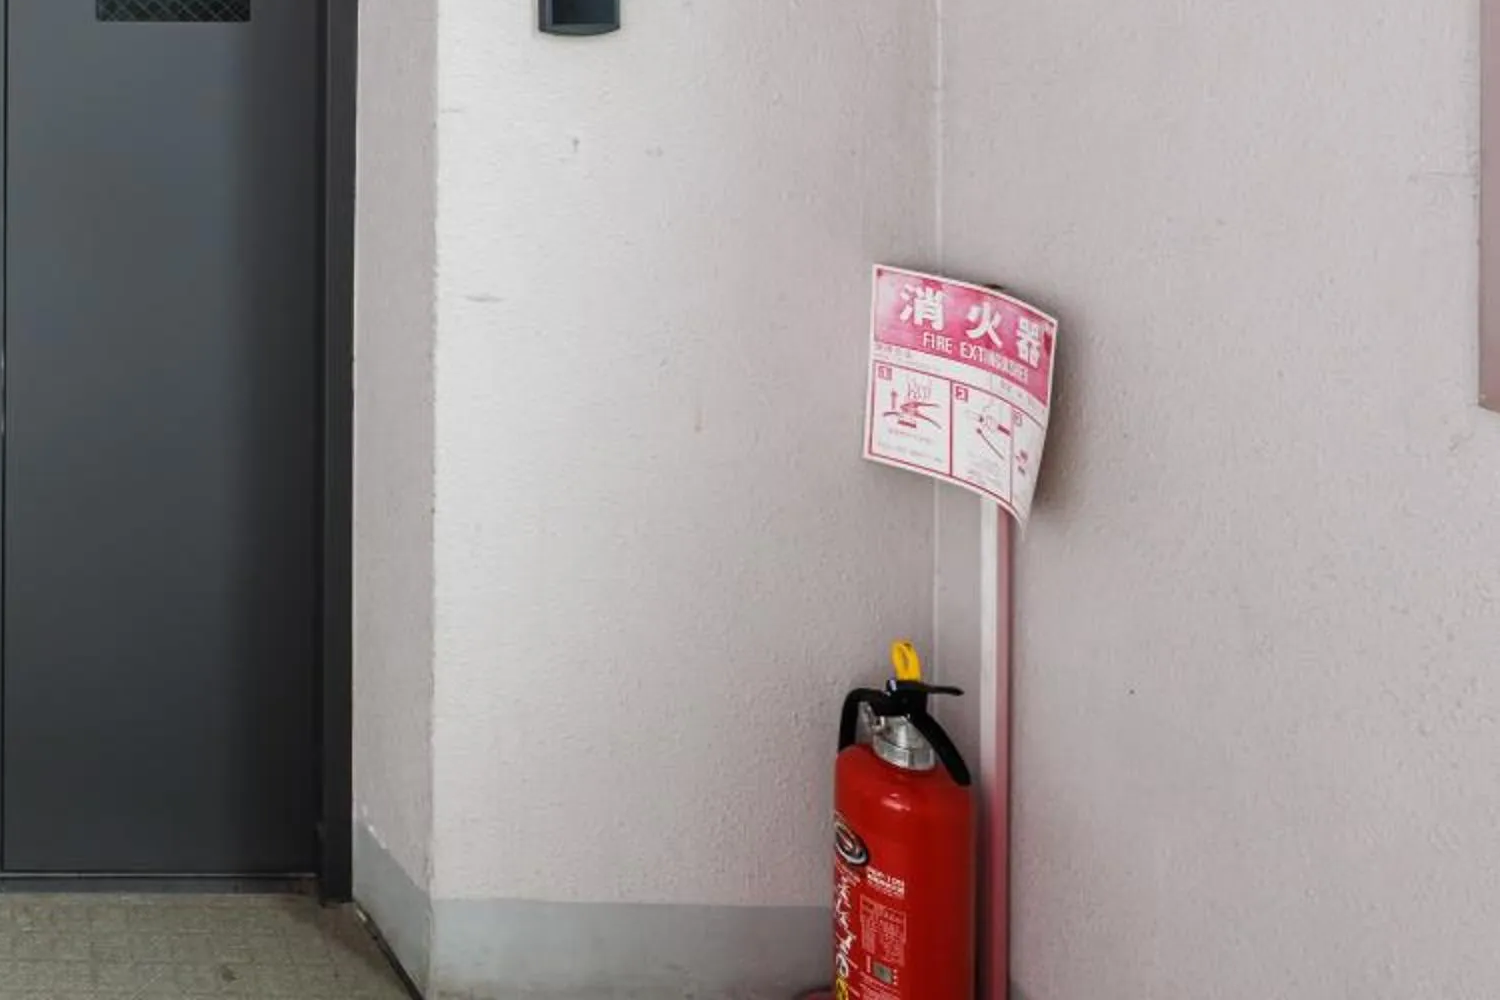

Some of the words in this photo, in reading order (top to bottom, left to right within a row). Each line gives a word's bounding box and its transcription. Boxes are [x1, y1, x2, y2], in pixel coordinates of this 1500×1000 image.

[900, 284, 1041, 369] 消火器
[923, 331, 953, 355] FIRE
